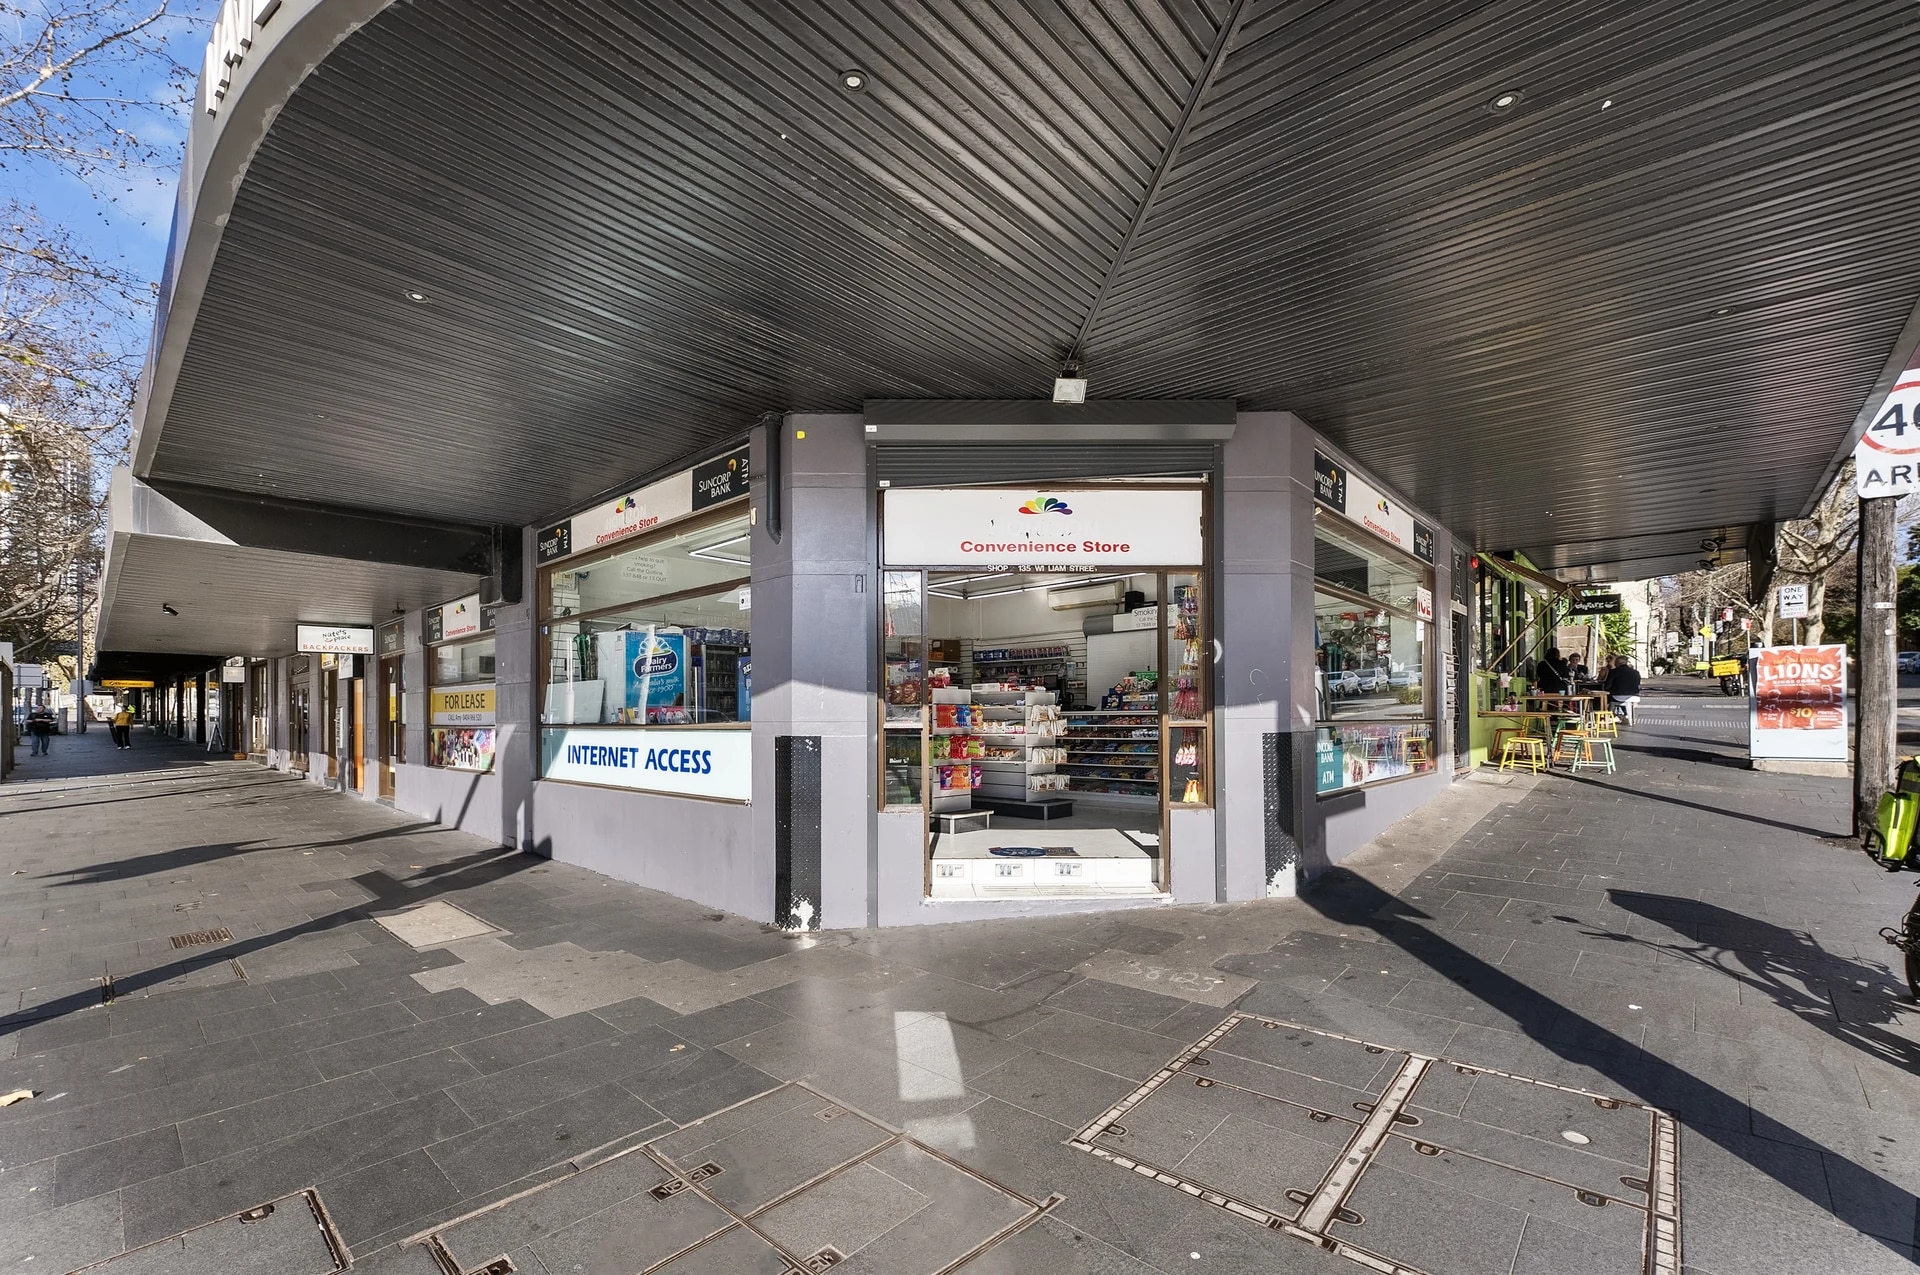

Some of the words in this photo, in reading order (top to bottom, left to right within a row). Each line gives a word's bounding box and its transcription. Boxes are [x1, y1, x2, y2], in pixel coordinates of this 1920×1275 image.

[741, 457, 749, 485] ATM
[1862, 463, 1920, 489] AR
[699, 471, 731, 492] SUNCORP
[1314, 470, 1334, 488] UNCORP
[711, 483, 731, 498] BANK
[1320, 484, 1333, 500] BANK
[595, 523, 637, 544] Convenience
[638, 516, 658, 529] Store
[1363, 515, 1390, 539] Convenience
[1391, 531, 1401, 545] Store
[540, 537, 559, 551] SUNCORP
[546, 545, 559, 557] BANK
[960, 540, 1077, 553] Convenience
[1082, 540, 1131, 553] Store
[1133, 607, 1158, 617] Smokin
[322, 629, 347, 638] Nate's
[333, 634, 351, 643] place
[302, 643, 369, 652] BACKPACKERS
[645, 656, 667, 667] Dairy
[1763, 662, 1838, 681] LIONS
[444, 694, 460, 710] FOR
[460, 693, 486, 709] LEASE
[1789, 707, 1813, 718] $10
[567, 744, 639, 769] INTERNET
[644, 748, 712, 775] ACCESS
[1321, 751, 1334, 763] BANK
[1322, 769, 1335, 785] ATM
